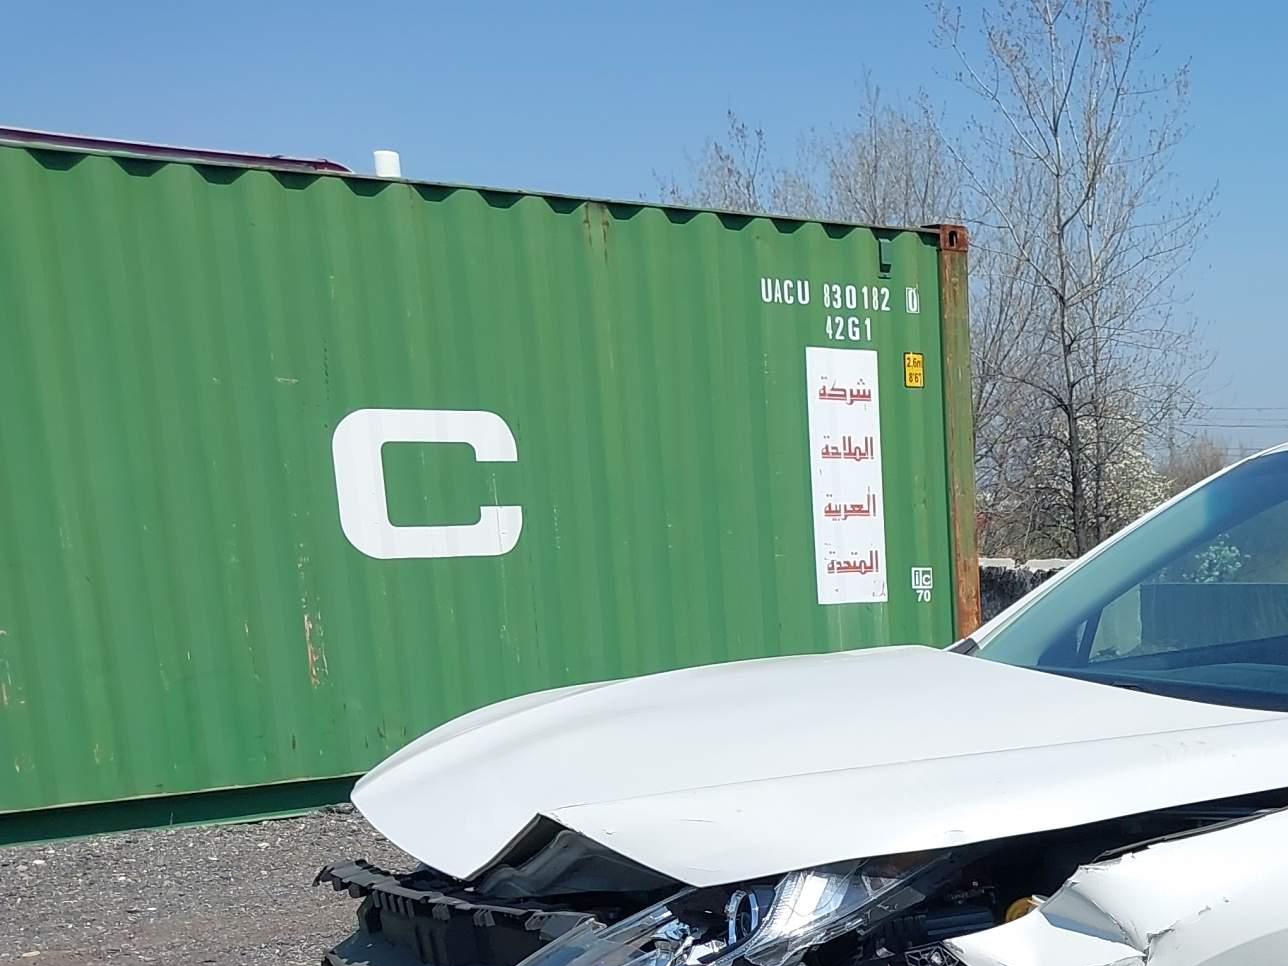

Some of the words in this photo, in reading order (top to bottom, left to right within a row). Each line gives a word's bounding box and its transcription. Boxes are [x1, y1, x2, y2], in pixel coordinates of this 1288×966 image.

[761, 278, 810, 304] UACU
[823, 283, 891, 311] 830182
[906, 286, 920, 314] 0
[826, 316, 872, 341] 42G1
[819, 376, 872, 406] شركة
[821, 435, 874, 462] الملاحة
[332, 408, 523, 560] C
[824, 493, 877, 521] العربية
[827, 550, 879, 575] المتحدة
[916, 590, 931, 602] 70
